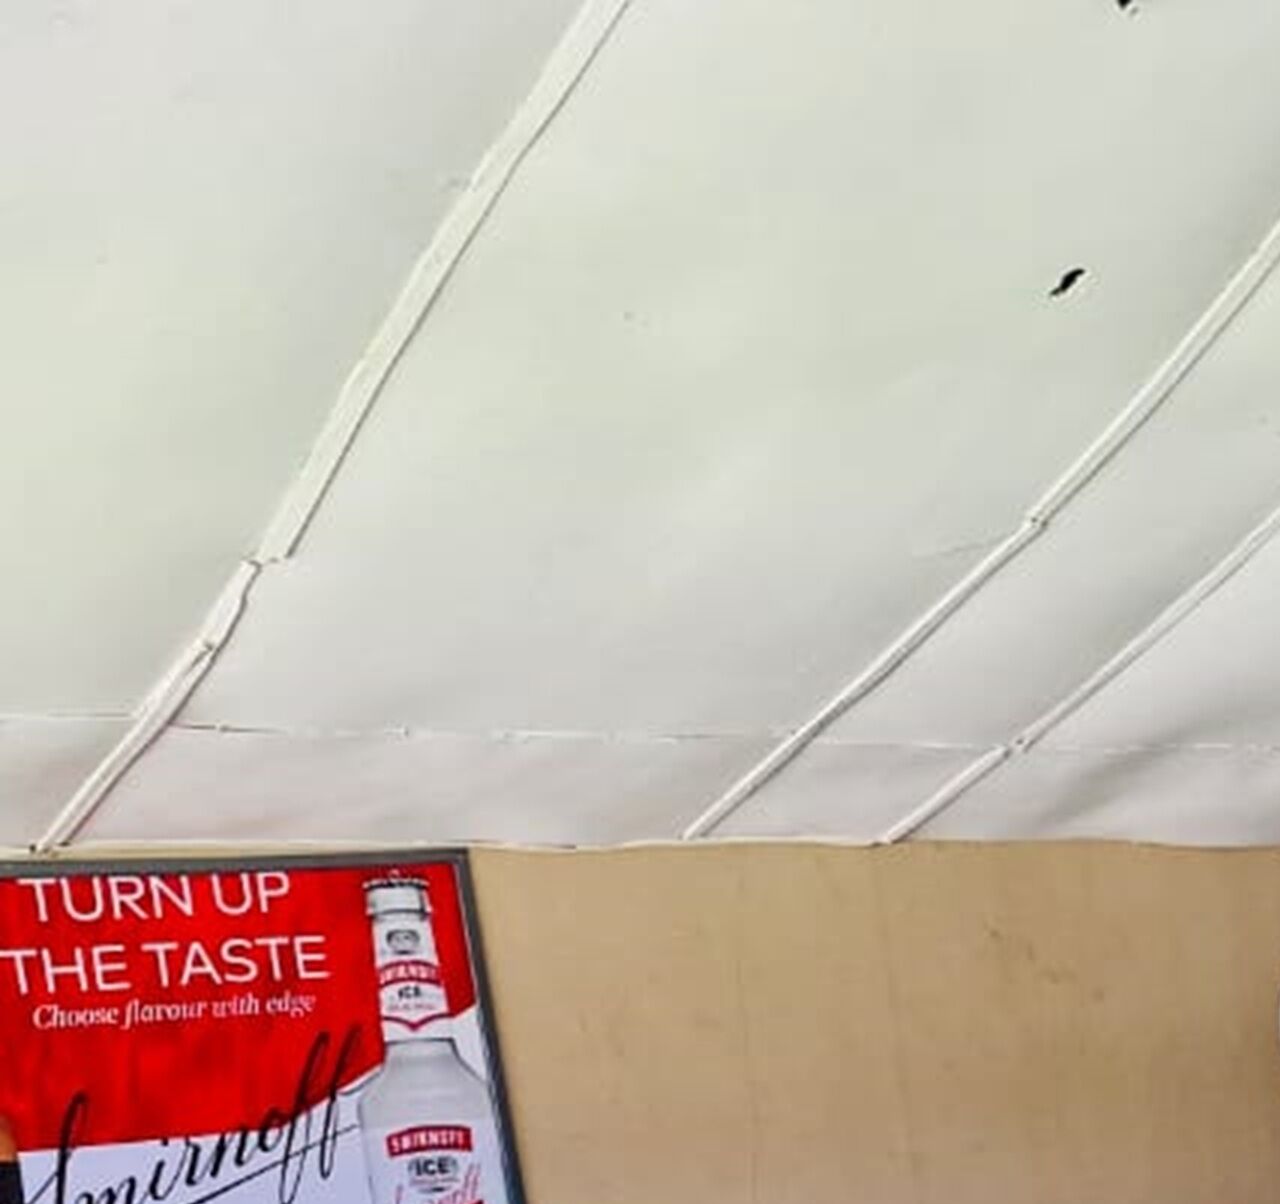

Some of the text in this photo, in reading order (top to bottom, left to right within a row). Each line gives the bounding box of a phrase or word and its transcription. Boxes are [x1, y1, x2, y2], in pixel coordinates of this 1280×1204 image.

[17, 870, 290, 922] TURN UP
[0, 935, 331, 995] THE TASTE
[32, 988, 317, 1031] Choose flavour with edge
[415, 1156, 450, 1176] ICE
